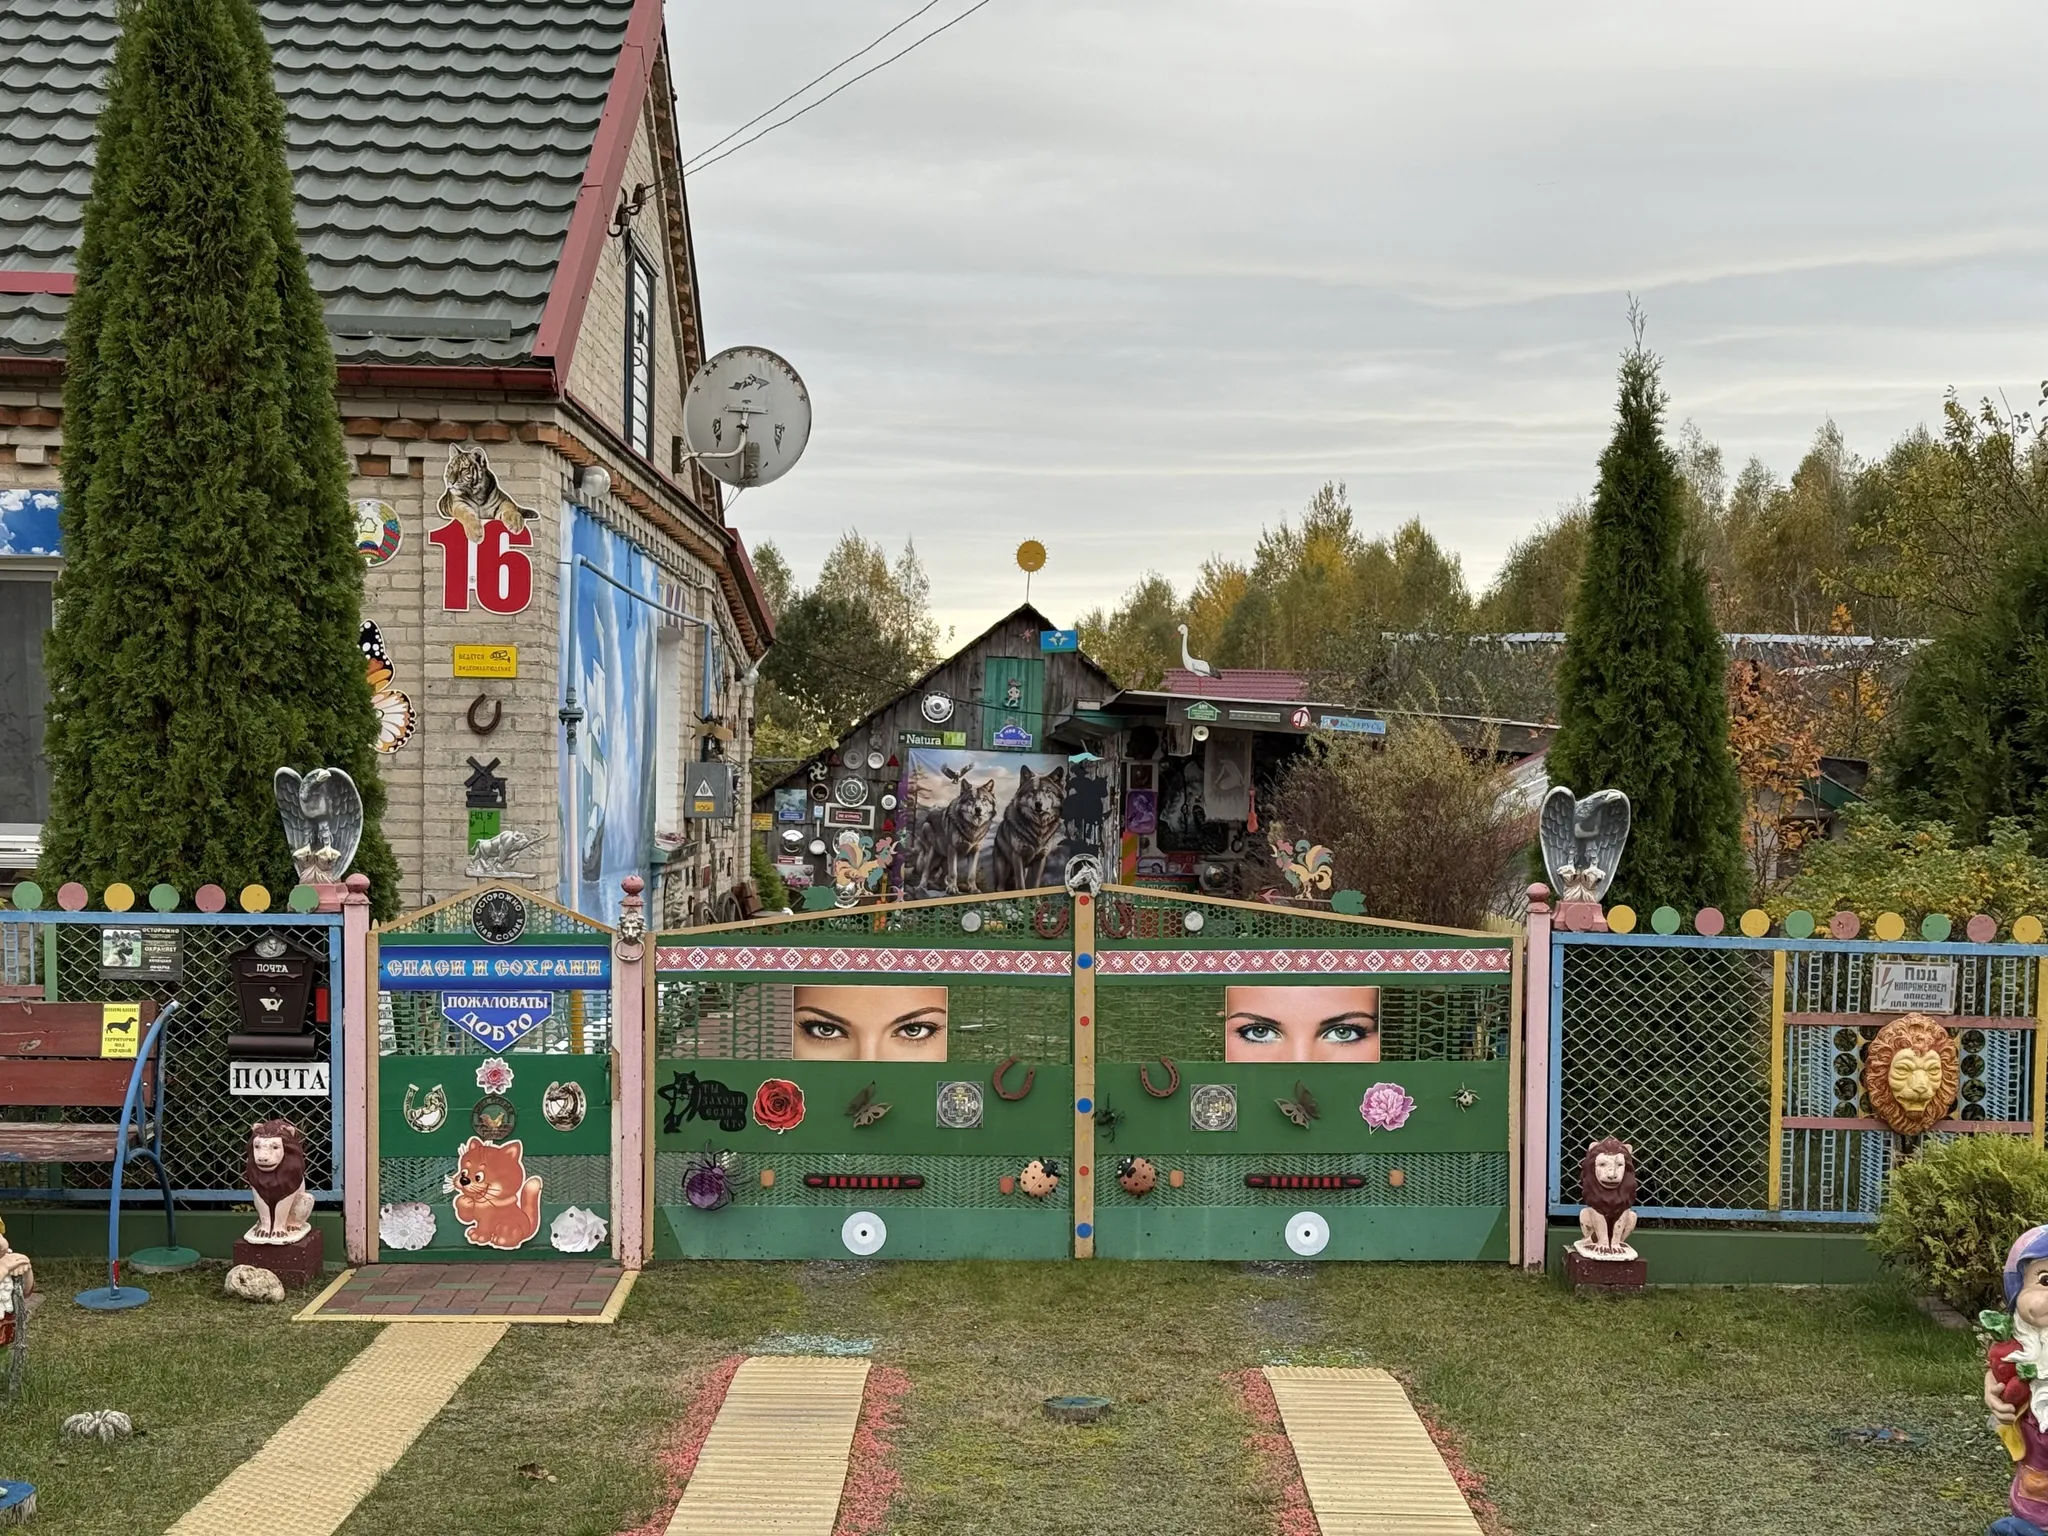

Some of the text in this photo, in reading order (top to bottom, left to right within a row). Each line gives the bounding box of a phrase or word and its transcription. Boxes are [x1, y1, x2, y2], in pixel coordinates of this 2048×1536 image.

[429, 518, 533, 614] 16
[906, 733, 942, 745] Natura
[475, 892, 522, 915] ОСТОРОЖНО
[475, 918, 524, 941] ЗЛАЯ СОБАКА
[256, 963, 289, 973] ПОЧТА
[387, 959, 602, 976] СПАСИ И СОХРАНИ
[1904, 967, 1937, 981] ПОД
[1894, 981, 1947, 993] НАПРЯЖЕНИЕМ
[1903, 992, 1937, 1000] ОПАСНО
[1910, 998, 1943, 1009] ЖИЗНИ!
[458, 1011, 533, 1042] ДОБРО
[233, 1068, 327, 1089] ПОЧТА
